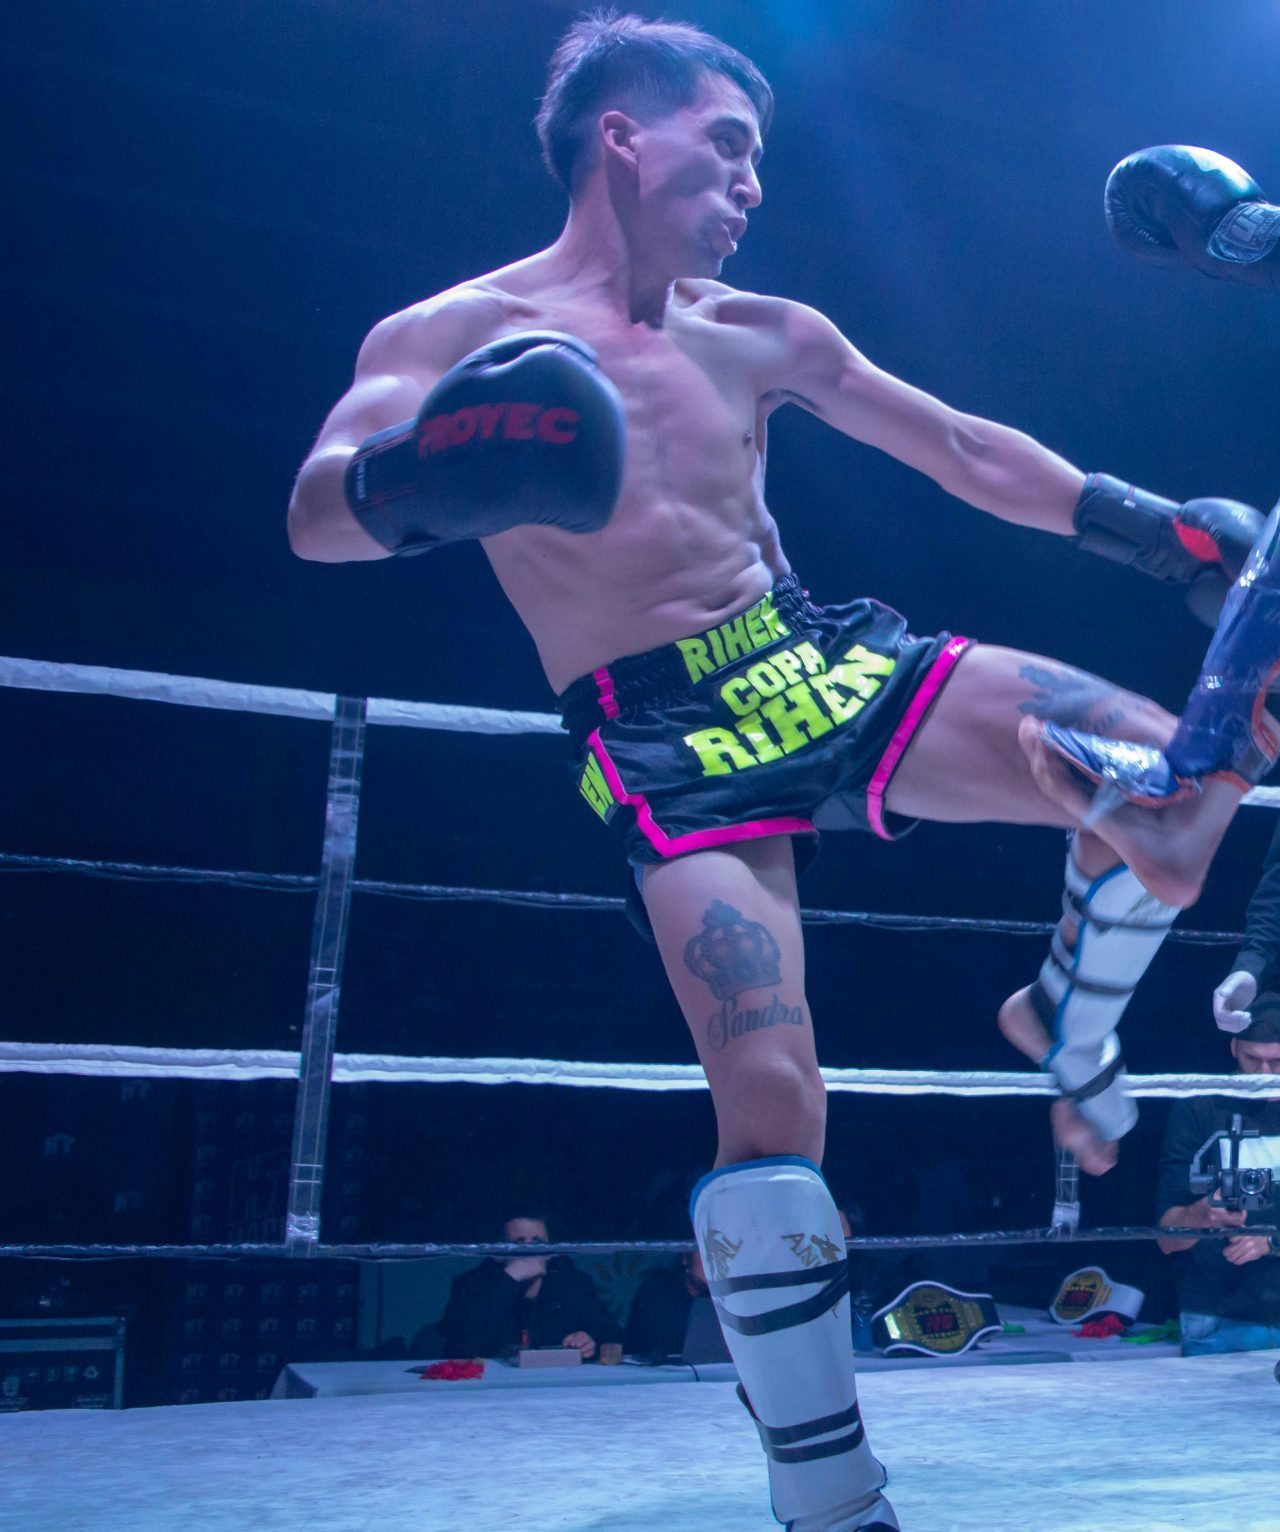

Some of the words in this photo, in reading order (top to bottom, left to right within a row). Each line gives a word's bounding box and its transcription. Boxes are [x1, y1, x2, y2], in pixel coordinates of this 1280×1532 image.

[683, 644, 897, 776] RIHEN
[721, 641, 827, 716] COPA
[707, 994, 804, 1050] Sandra
